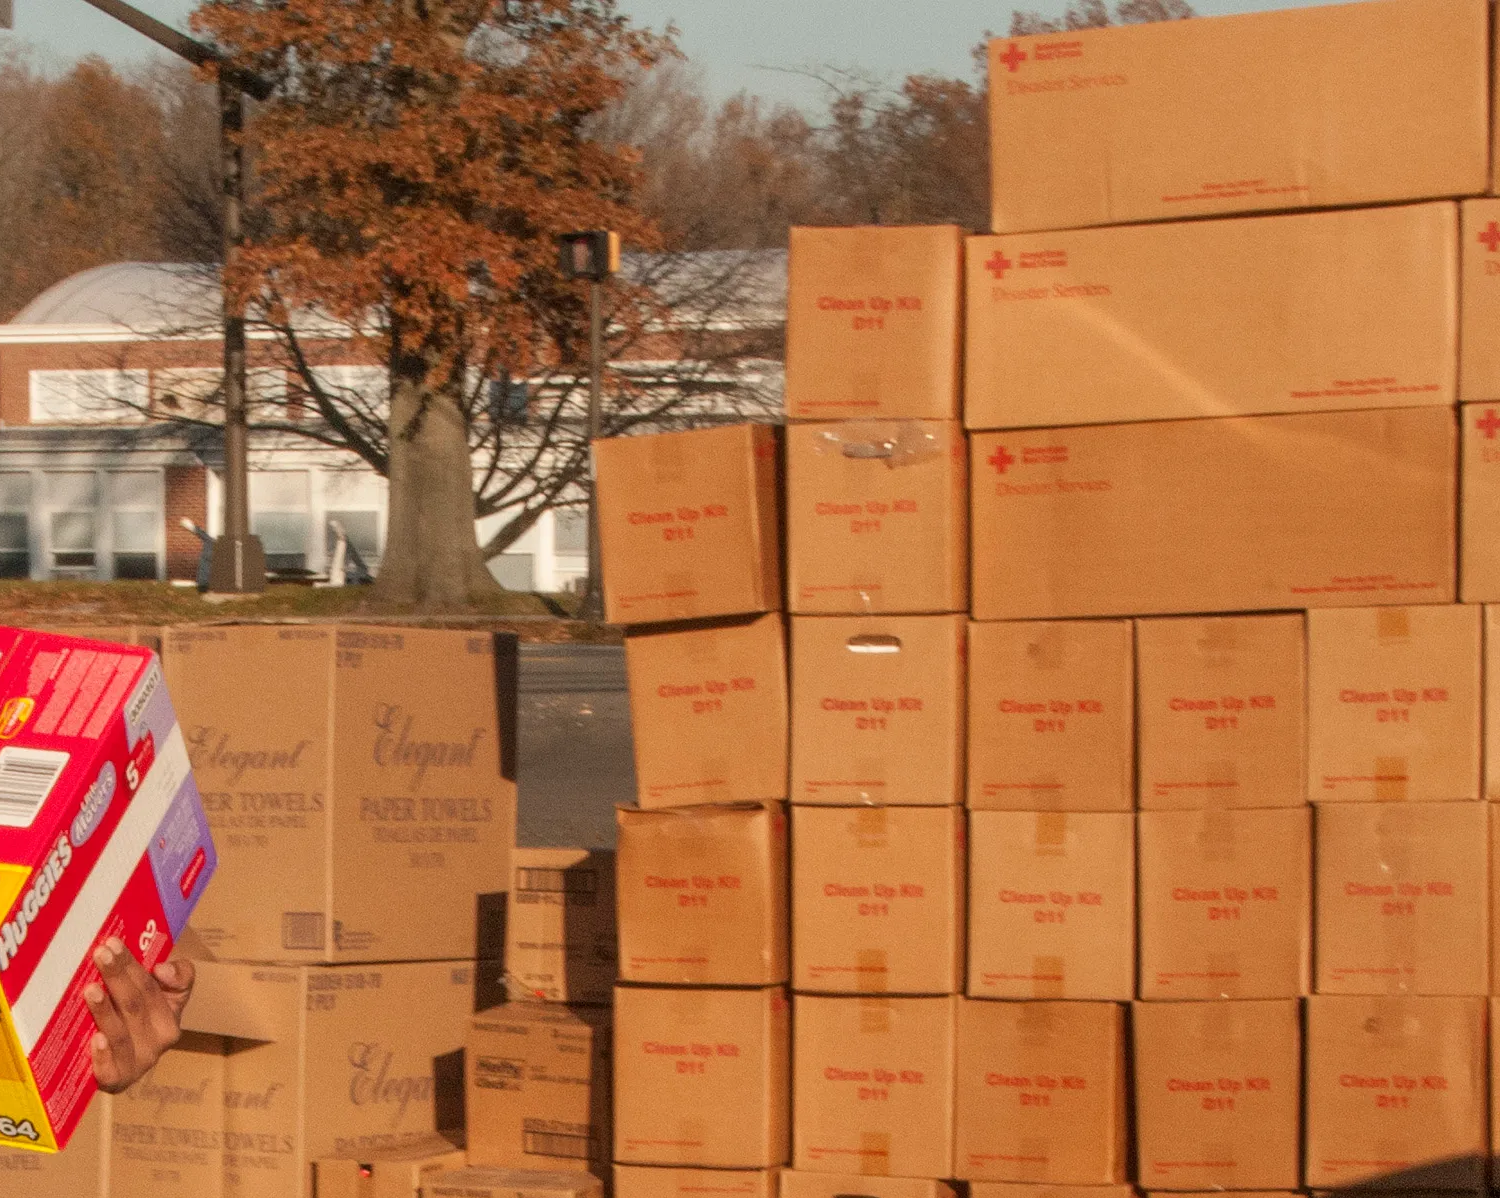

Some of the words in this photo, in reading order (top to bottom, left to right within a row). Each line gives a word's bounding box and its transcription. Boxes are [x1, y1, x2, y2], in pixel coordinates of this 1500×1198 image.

[373, 701, 487, 793] Elegant
[347, 1041, 433, 1129] Elega
[222, 1131, 294, 1154] OWELS
